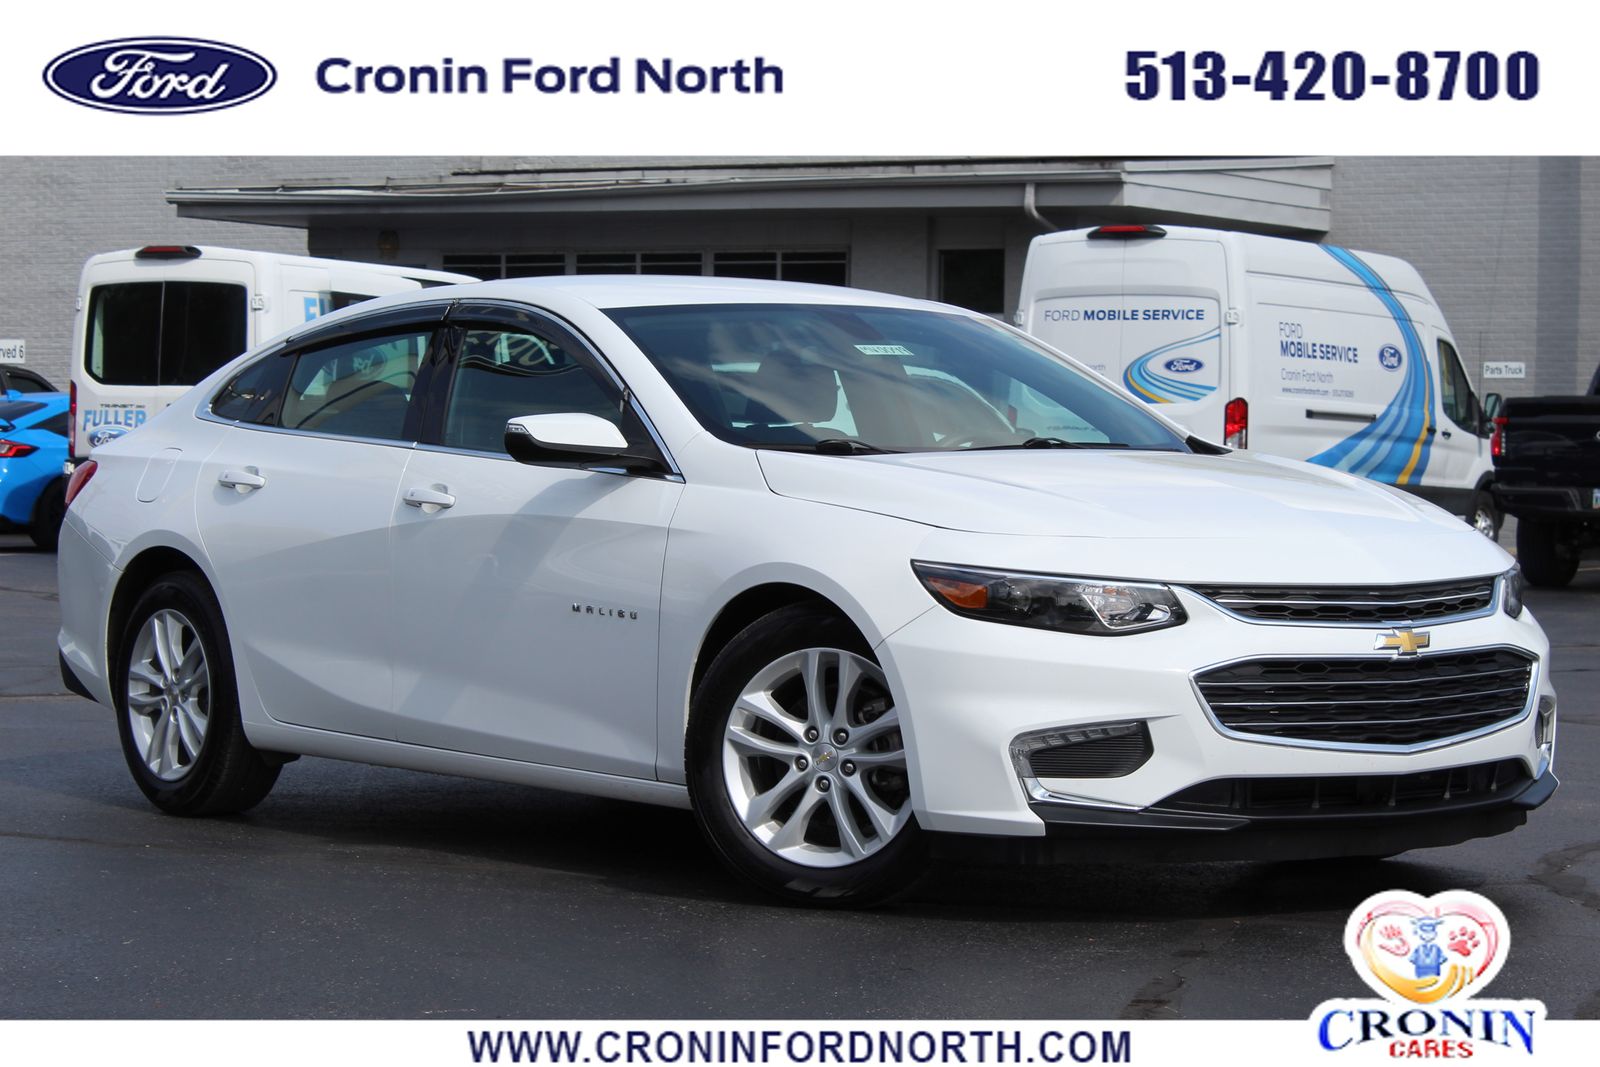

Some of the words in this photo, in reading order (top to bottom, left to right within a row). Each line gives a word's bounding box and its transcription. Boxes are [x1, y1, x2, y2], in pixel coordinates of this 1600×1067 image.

[1044, 310, 1081, 322] FORD
[1083, 309, 1140, 321] MOBILE
[1142, 309, 1205, 321] SERVICE
[1279, 321, 1304, 339] FORD
[1280, 340, 1318, 360] MOBILE
[1319, 343, 1359, 364] SERVICE
[1485, 365, 1502, 375] Parts
[1504, 365, 1523, 376] Truck
[572, 603, 638, 620] MALIBU
